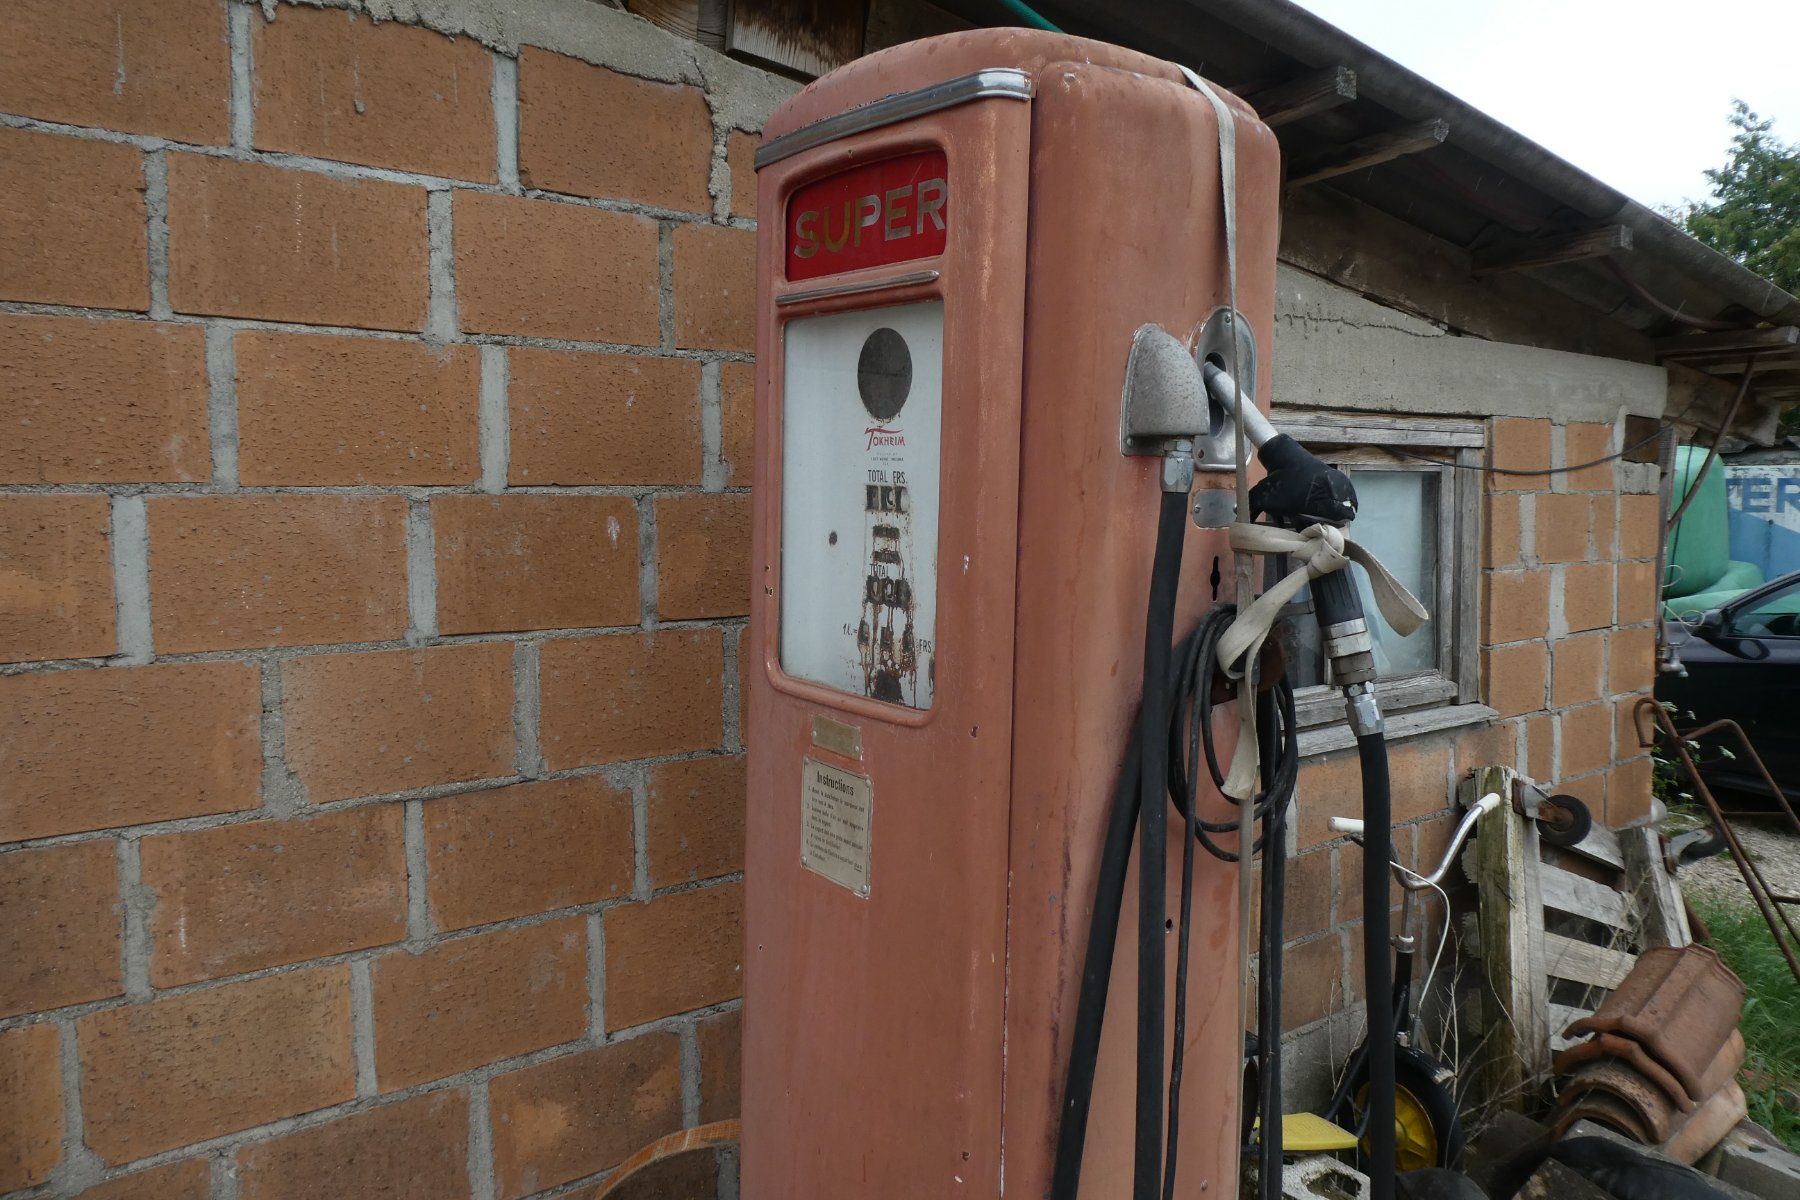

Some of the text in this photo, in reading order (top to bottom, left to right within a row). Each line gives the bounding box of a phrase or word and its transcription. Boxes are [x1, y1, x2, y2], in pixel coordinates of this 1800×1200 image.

[794, 178, 947, 259] SUPER
[864, 427, 906, 452] TOKHEIM
[868, 469, 888, 482] TOTAL
[919, 639, 932, 653] FRS
[817, 771, 854, 796] Instructions
